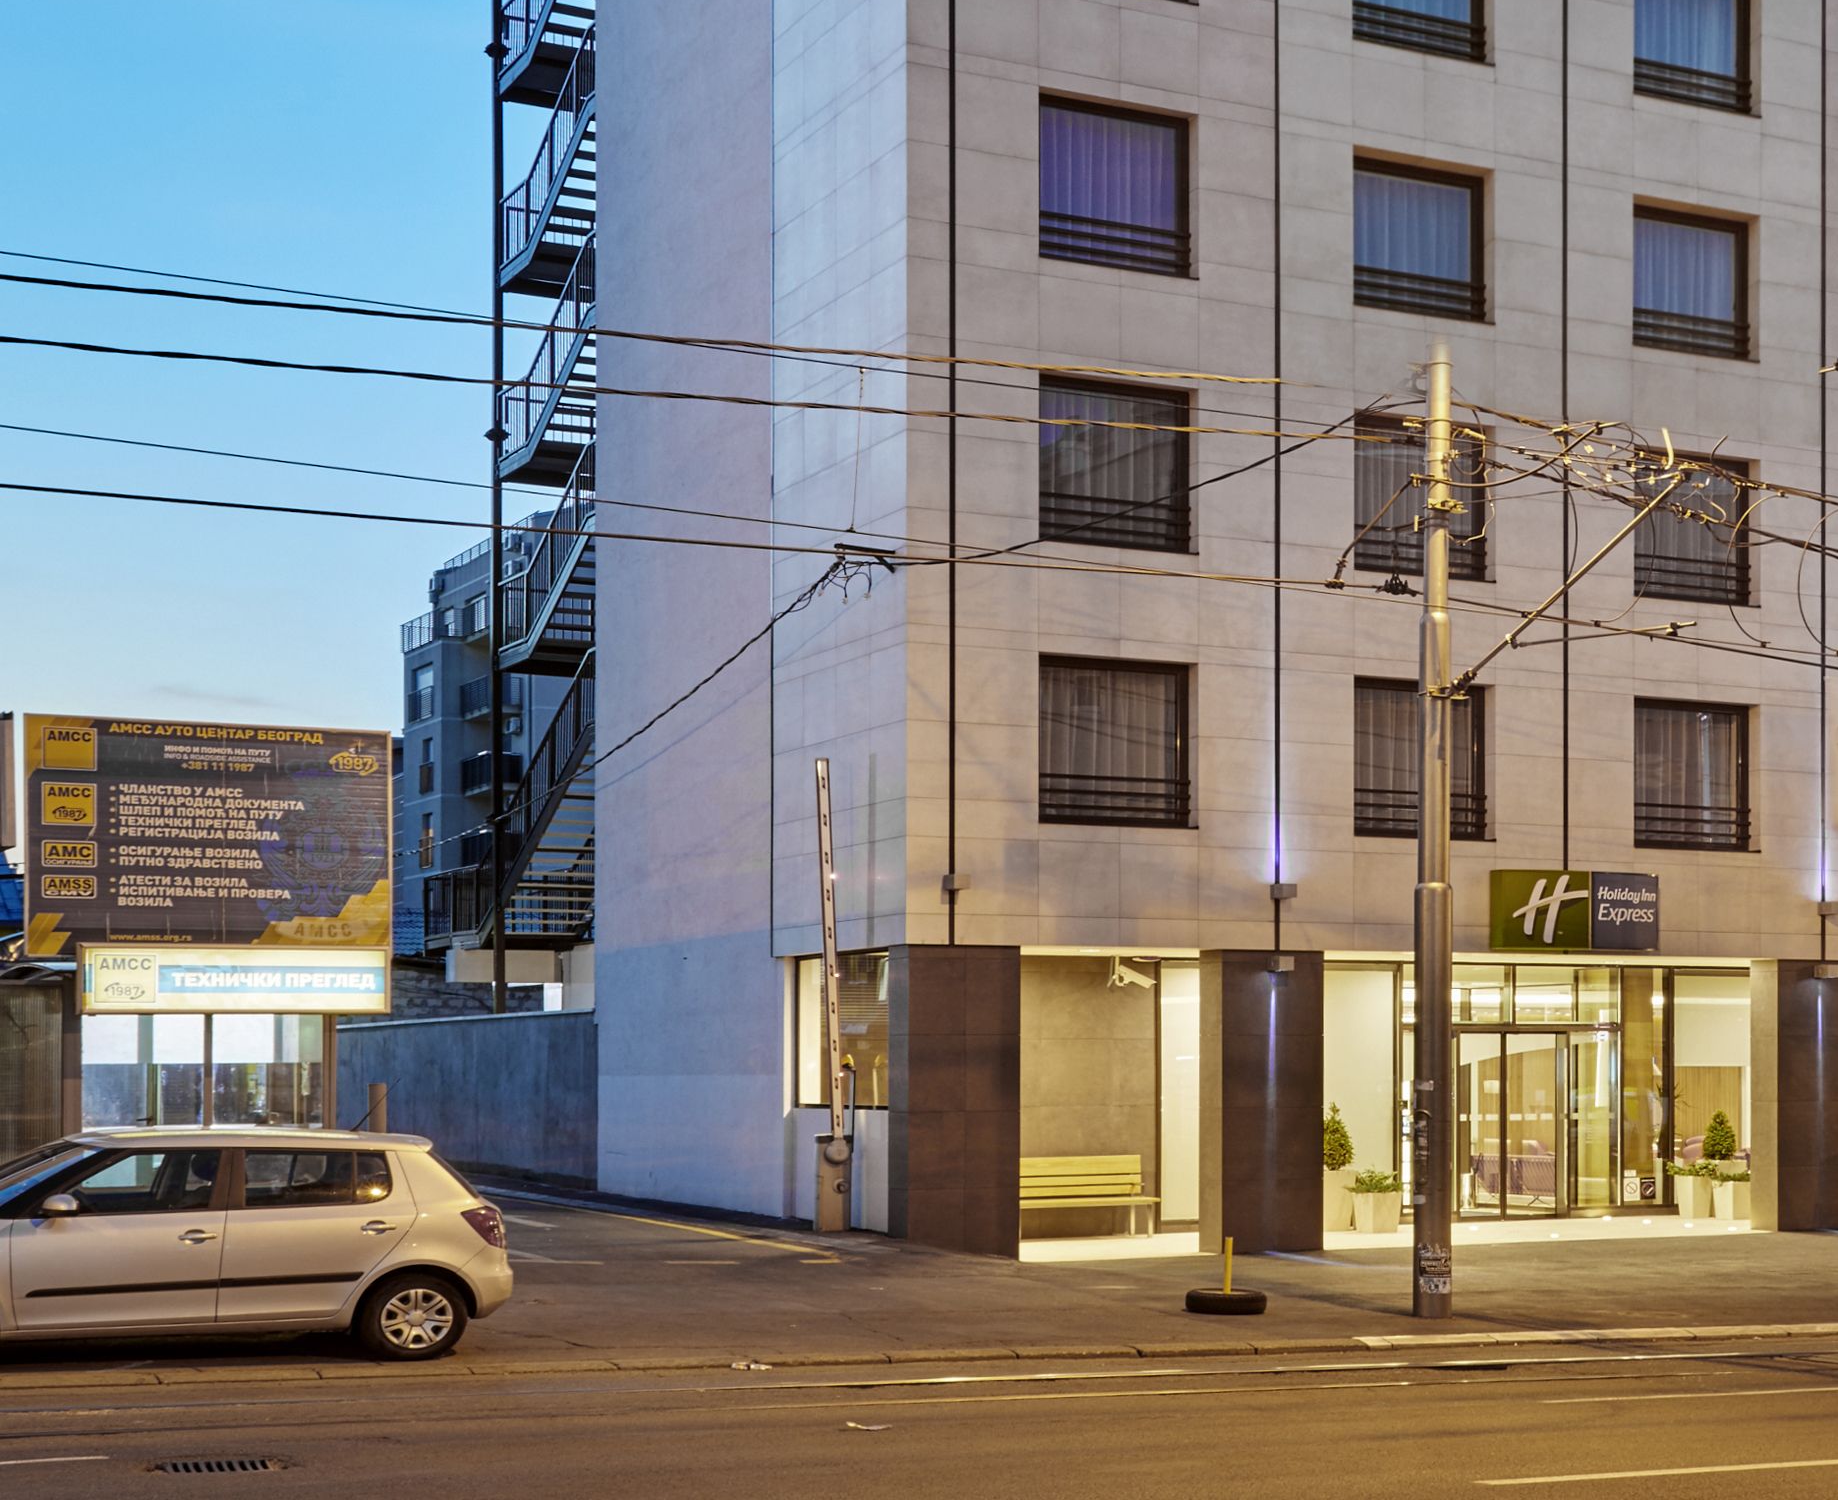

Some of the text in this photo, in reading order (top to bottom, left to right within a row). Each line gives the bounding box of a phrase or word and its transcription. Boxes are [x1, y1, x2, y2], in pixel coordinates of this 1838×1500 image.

[47, 730, 92, 742] АМСС
[109, 722, 324, 744] АМСС АУТО ЦЕНТАР БЕОГРАД
[164, 745, 191, 753] ИНФО
[248, 749, 271, 757] ПУТУ
[181, 761, 255, 772] +381 11 1987
[338, 757, 372, 770] 1987
[47, 787, 92, 798] АМСС
[119, 784, 243, 797] ЧЛАНСТВО У АМСС
[119, 795, 305, 811] МЕЂУНАРОДНА ДОКУМЕНТА
[57, 808, 82, 818] 1987
[119, 806, 284, 820] ШЛЕП И ПОМОЋ НА ПУТУ
[119, 816, 257, 830] ТЕХНИЧКИ ПРЕГЛЕД
[119, 827, 280, 841] РЕГИСТРАЦИЈА ВОЗИЛА
[47, 846, 92, 859] АМС
[119, 845, 259, 859] ОСИГУРАЊЕ ВОЗИЛА
[119, 856, 263, 869] ПУТНО ЗДРАВСТВЕНО
[47, 879, 92, 890] AMSS
[119, 875, 248, 887] АТЕСТИ ЗА ВОЗИЛА
[119, 886, 291, 899] ИСПИТИВАЊЕ И ПРОВЕРА
[1597, 886, 1656, 904] Holiday Inn
[117, 896, 173, 907] ВОЗИЛА
[1598, 903, 1655, 926] Express
[109, 934, 193, 943] www.amss.org.rs
[99, 957, 152, 971] АМСС
[171, 972, 376, 990] ТЕХНИЧКИ ПРЕГЛЕД
[111, 986, 140, 996] 1987
